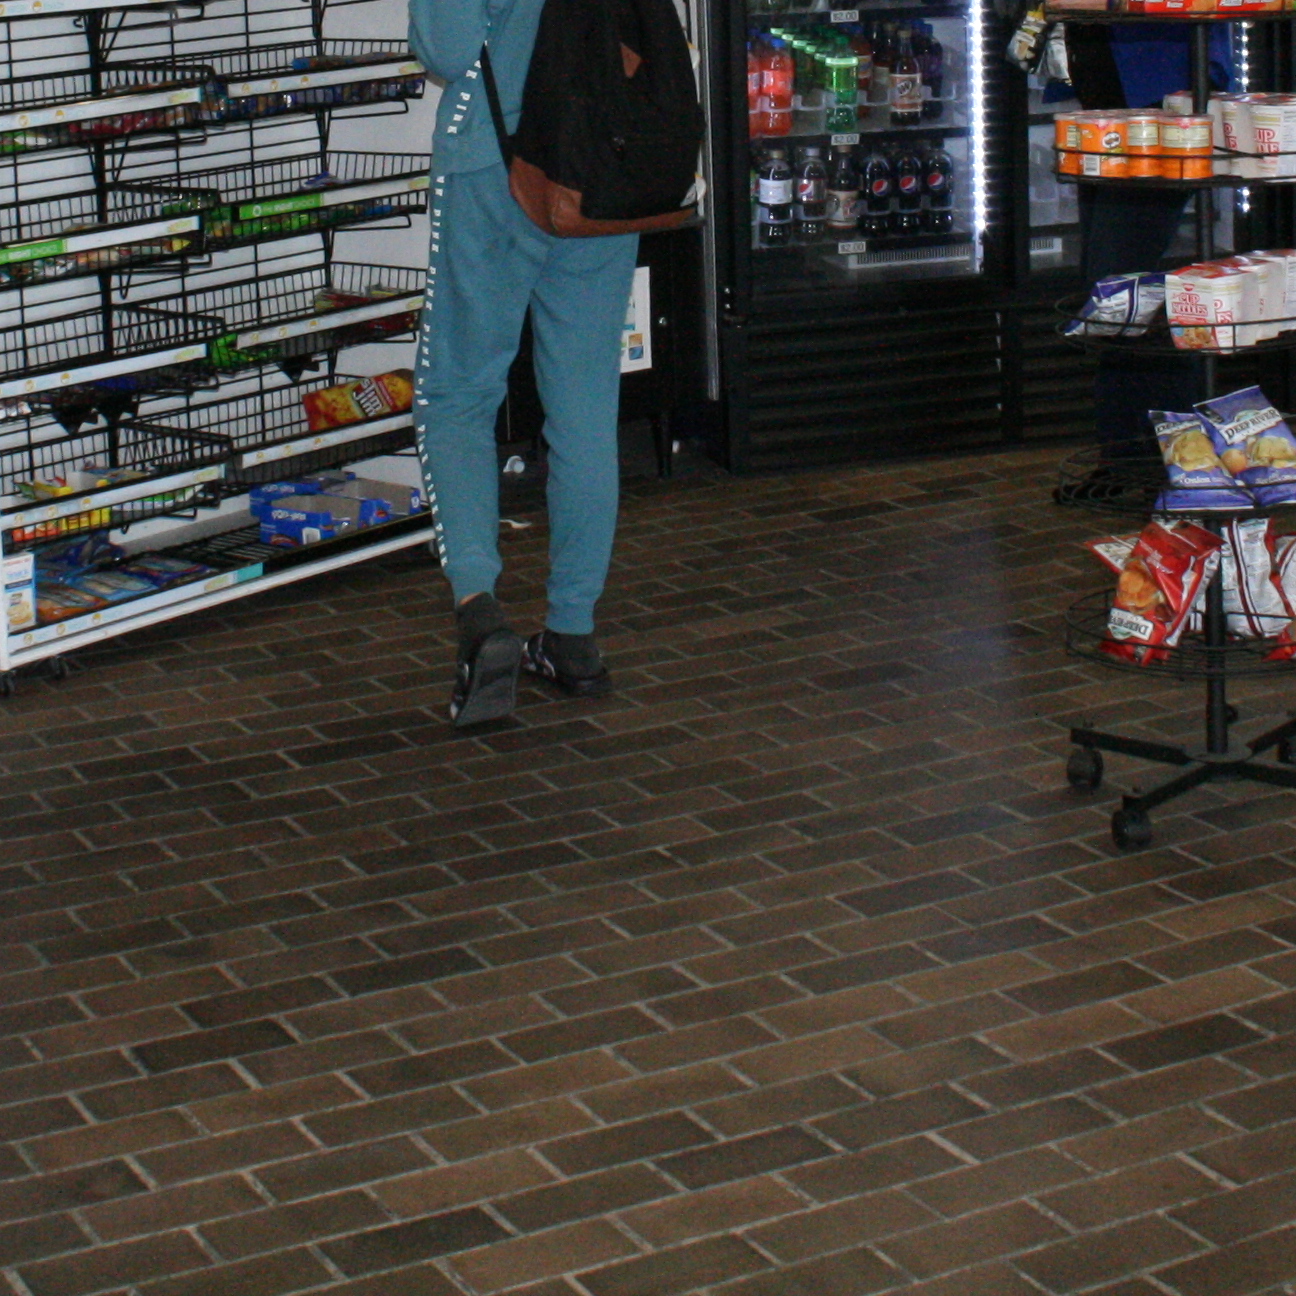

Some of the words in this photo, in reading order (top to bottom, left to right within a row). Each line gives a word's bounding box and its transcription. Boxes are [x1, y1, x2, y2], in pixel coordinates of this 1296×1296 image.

[833, 11, 857, 21] $2.00
[833, 133, 858, 144] $2.00
[839, 242, 864, 253] $2.00
[1224, 420, 1250, 439] DEEP
[1250, 408, 1280, 427] RIVER
